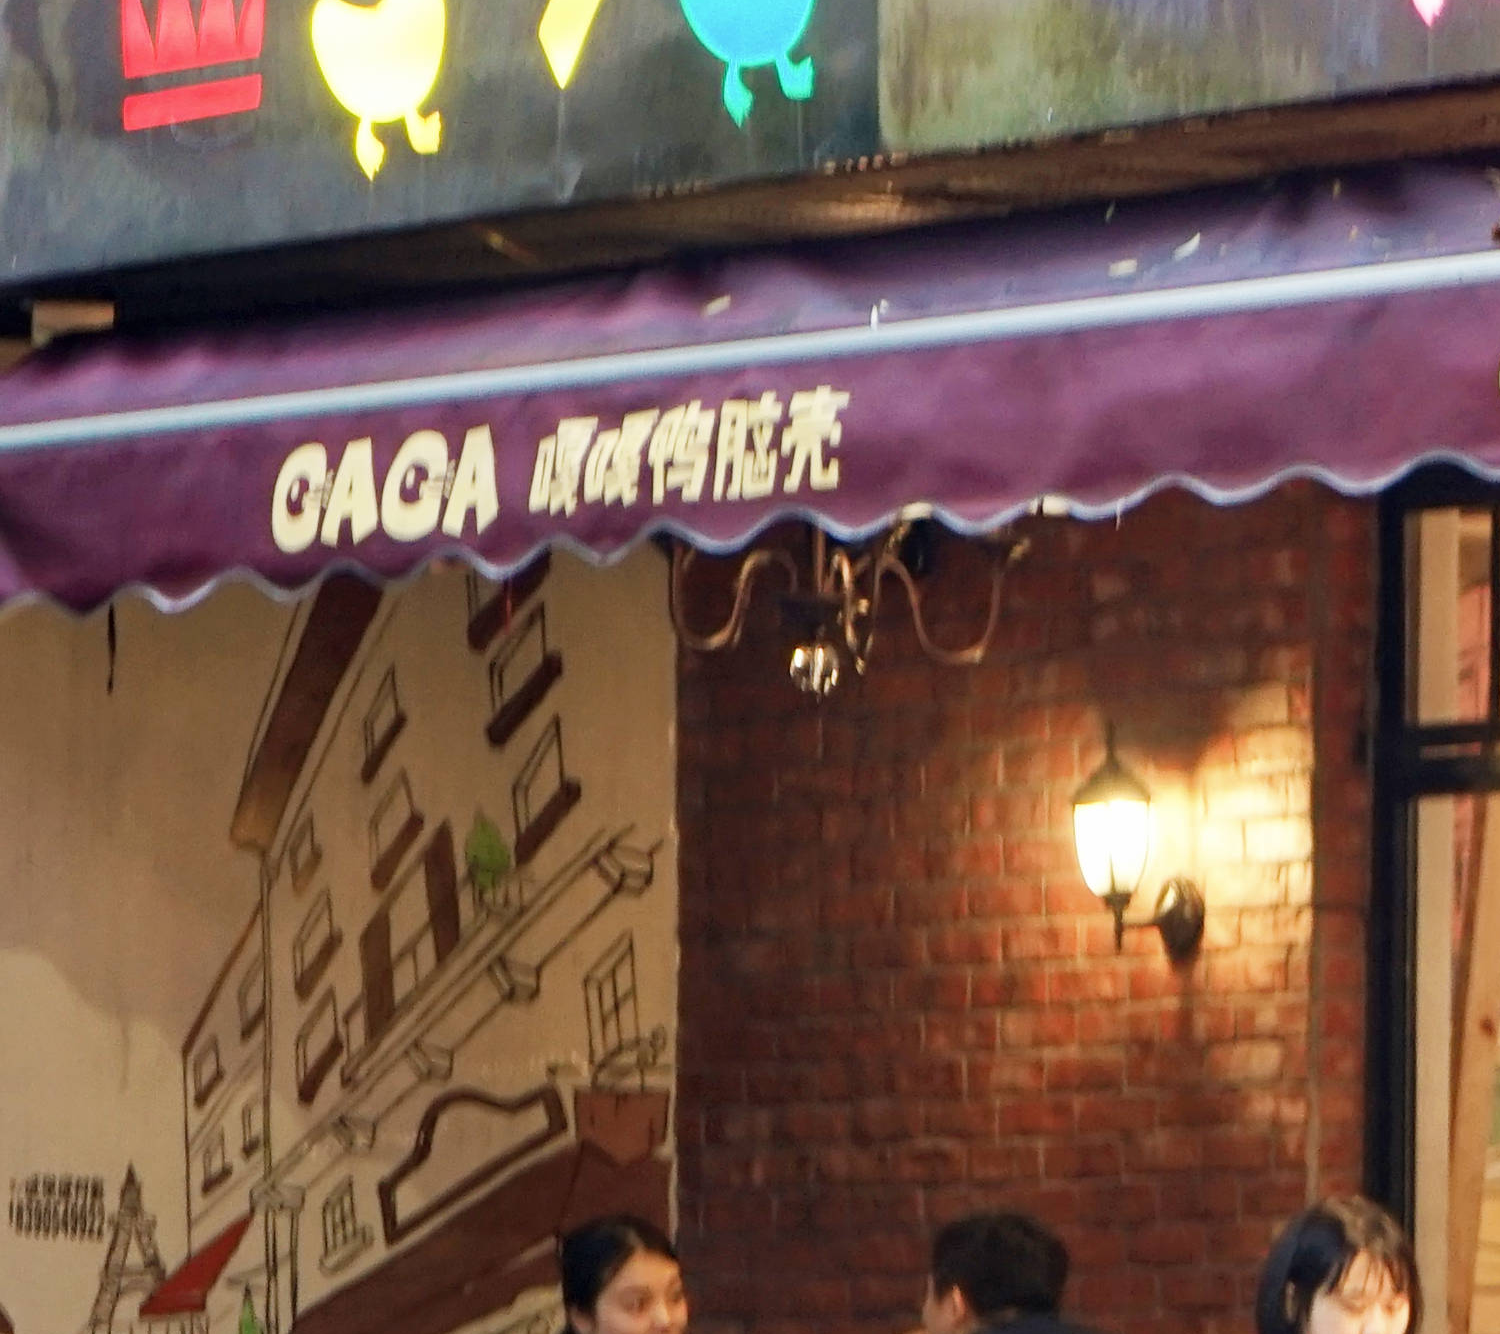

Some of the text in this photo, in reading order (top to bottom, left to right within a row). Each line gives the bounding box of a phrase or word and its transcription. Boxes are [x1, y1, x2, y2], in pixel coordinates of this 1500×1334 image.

[271, 384, 850, 555] GAGA 嘎嘎鸭脑壳
